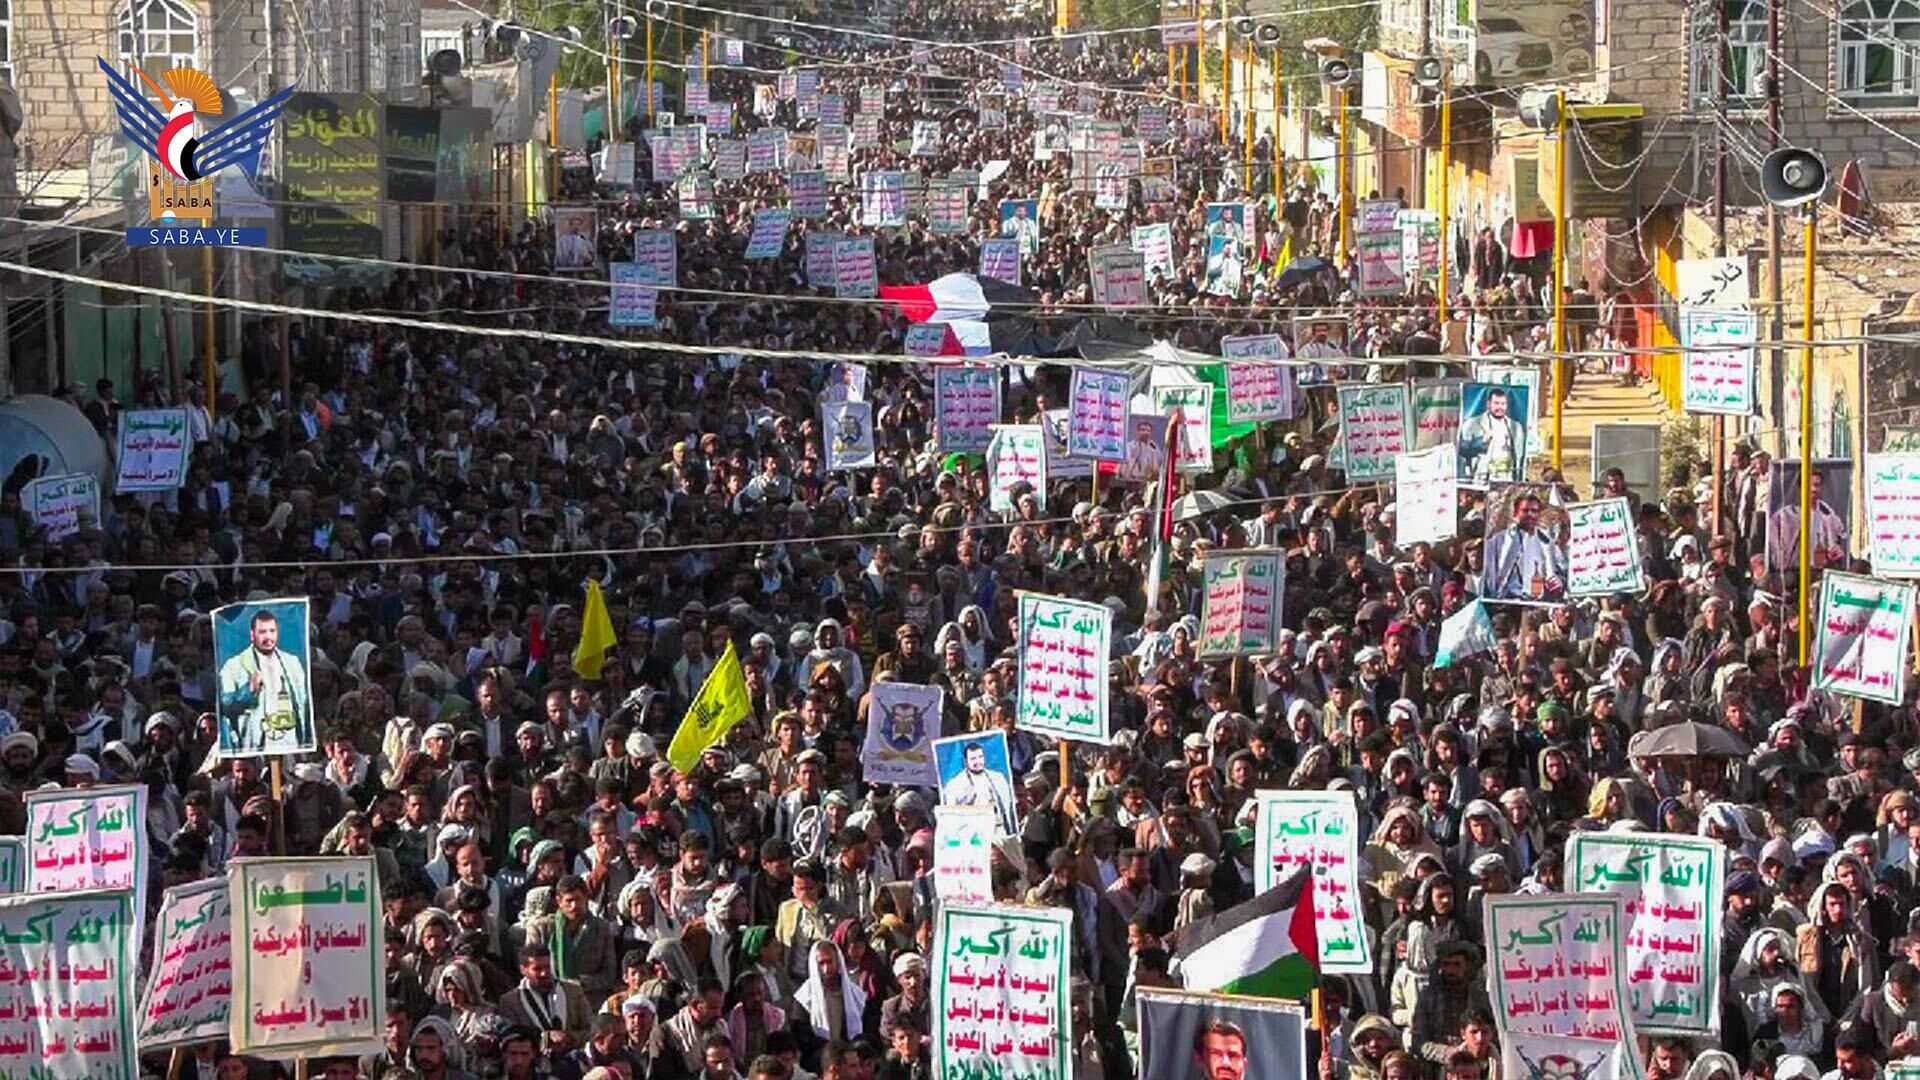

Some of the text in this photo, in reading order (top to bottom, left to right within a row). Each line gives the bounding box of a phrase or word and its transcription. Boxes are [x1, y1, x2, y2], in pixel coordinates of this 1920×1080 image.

[35, 802, 131, 846] الله أكبر
[35, 841, 133, 871] الموت لأمريكا
[1585, 848, 1703, 890] الله أكبر
[251, 872, 366, 916] قاطعوا
[65, 907, 117, 943] الله
[1651, 901, 1702, 922] الموت
[253, 917, 366, 958] البضائع الأمريكية
[951, 922, 1058, 962] الله أكبر
[1501, 909, 1568, 956] أكبر
[1573, 912, 1610, 942] الله
[1649, 933, 1700, 955] الموت
[0, 951, 115, 986] الموت لأمريك
[304, 961, 312, 984] و
[949, 963, 1056, 994] الموت لأمريكا
[1503, 952, 1612, 982] الموت لأمريكا
[1629, 960, 1700, 984] اللعنة على
[58, 994, 116, 1022] الموت
[254, 996, 368, 1030] الإسرائيلية
[947, 998, 1055, 1028] الموت لإسرائيل
[1508, 989, 1616, 1018] الموت لإسرائيل
[1646, 989, 1700, 1019] النصر
[42, 1032, 66, 1059] على
[74, 1029, 119, 1054] اللعنة
[947, 1031, 1055, 1058] اللعنة على اليهود
